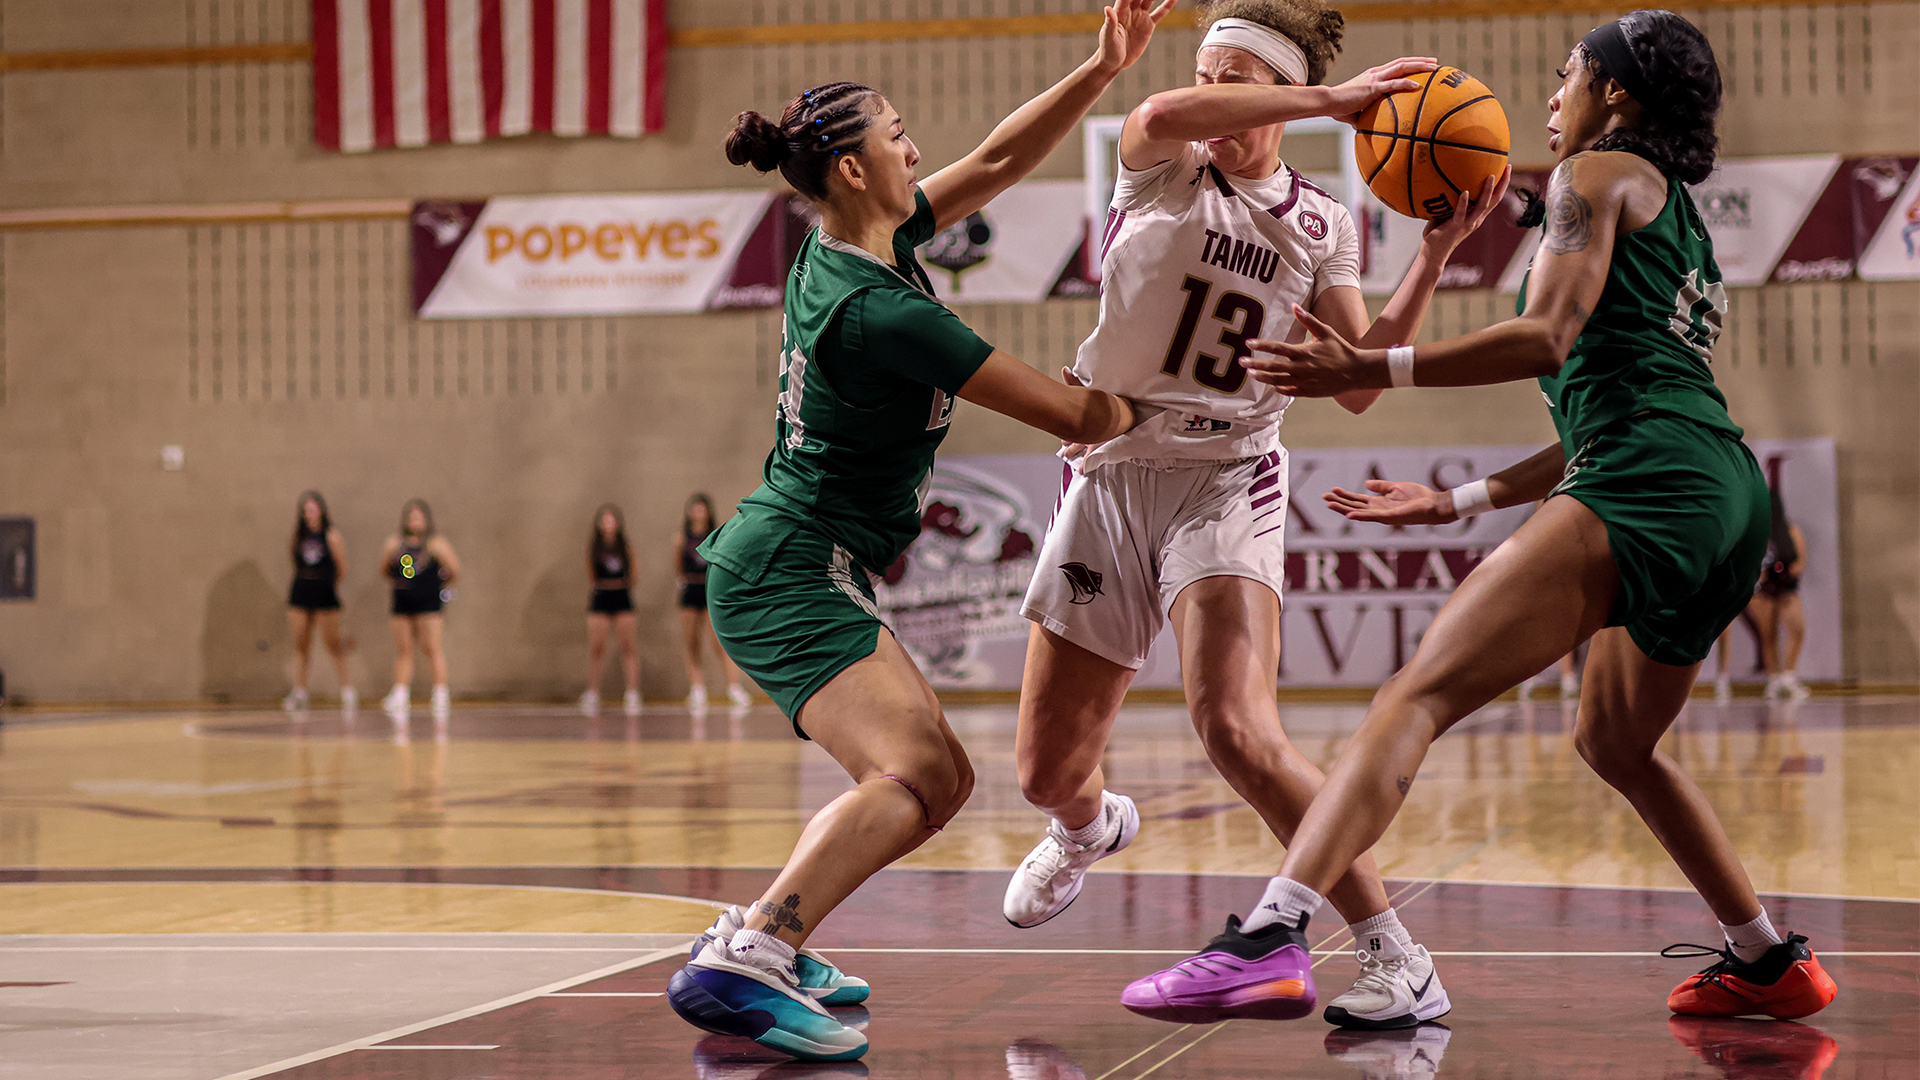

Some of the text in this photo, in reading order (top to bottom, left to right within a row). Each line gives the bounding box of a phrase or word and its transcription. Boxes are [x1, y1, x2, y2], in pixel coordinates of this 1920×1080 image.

[1304, 214, 1323, 236] PA
[1201, 228, 1280, 285] TAMIU
[1160, 273, 1267, 395] 13
